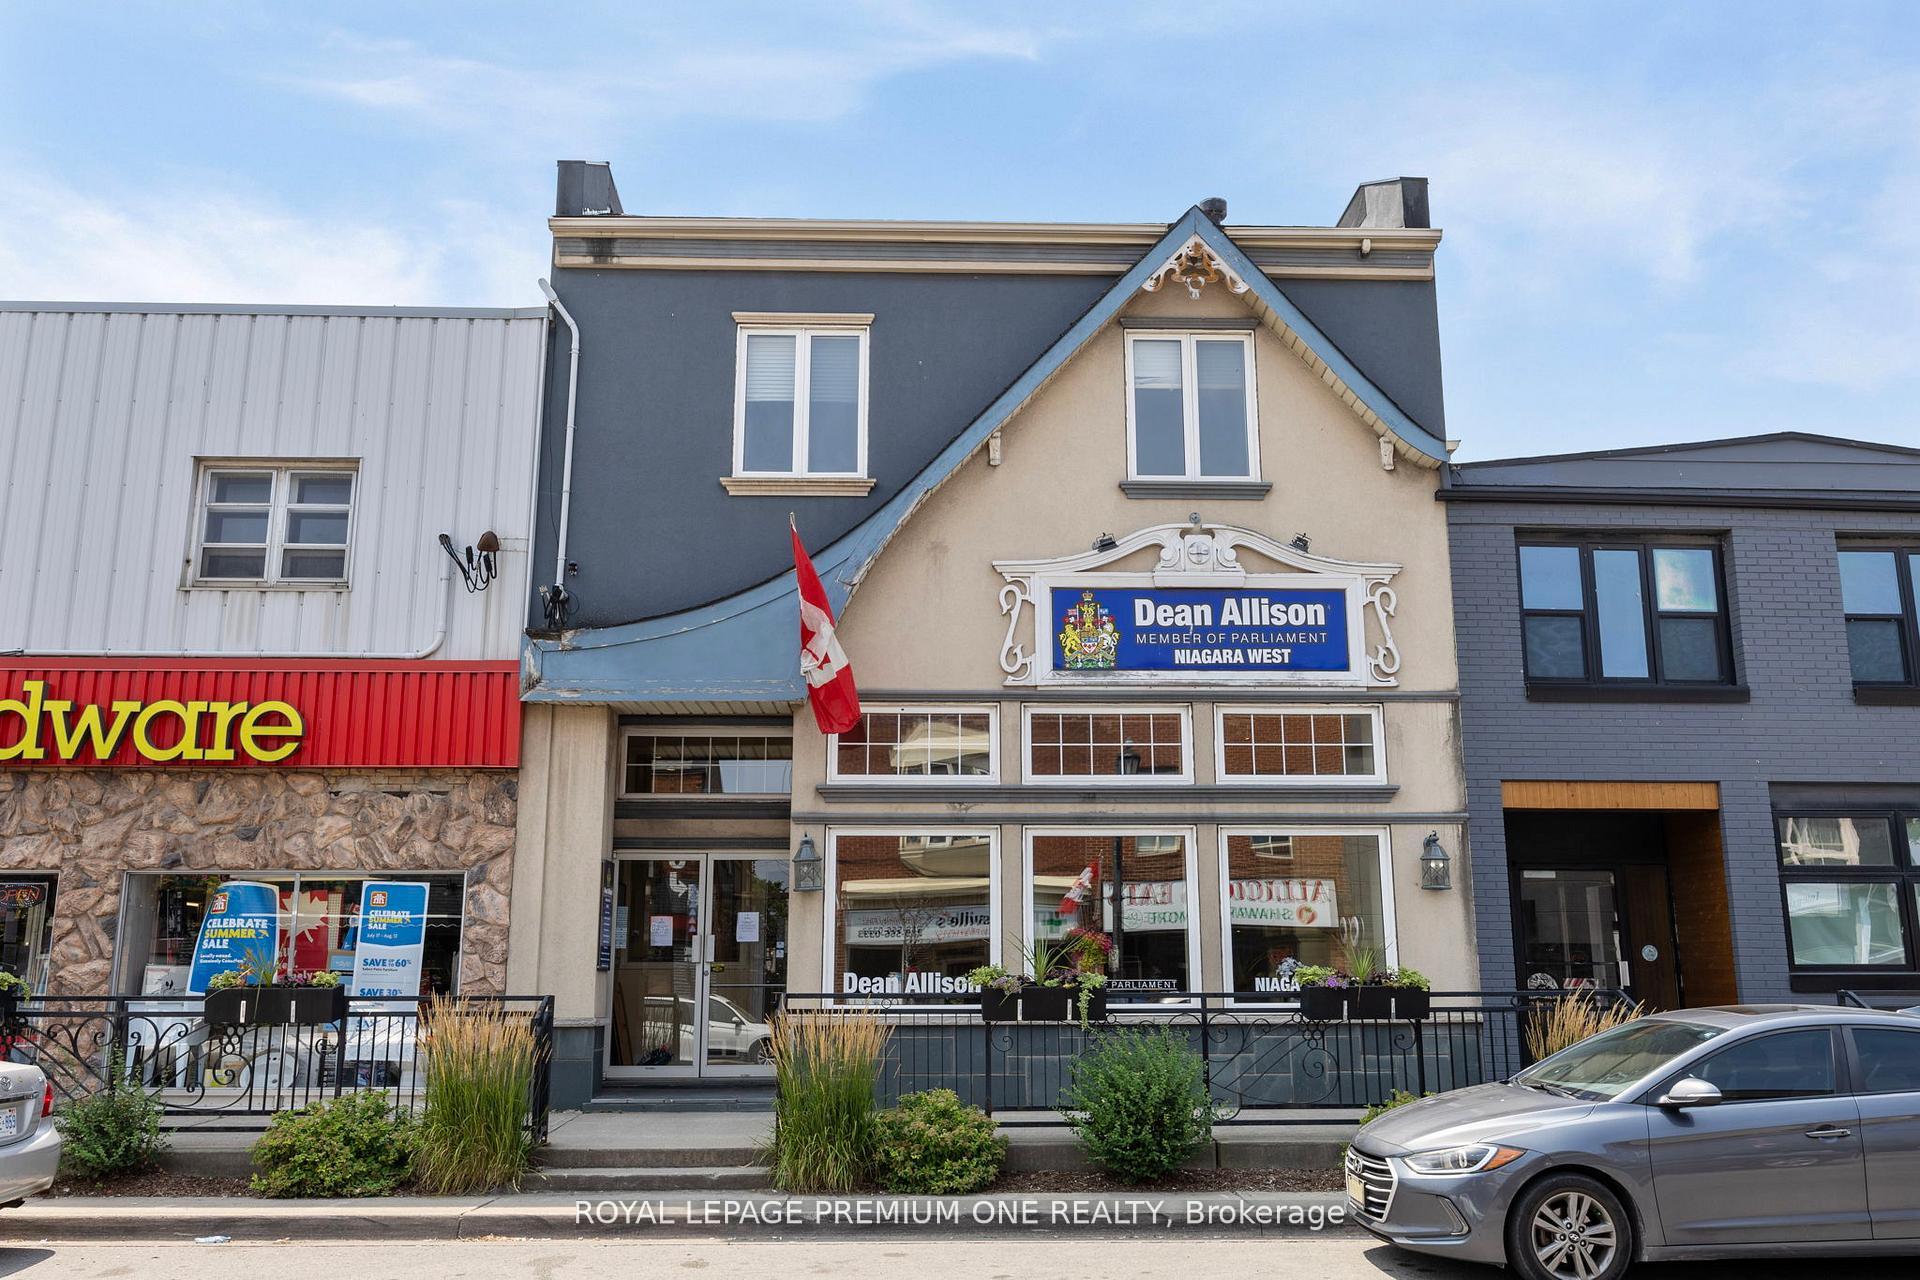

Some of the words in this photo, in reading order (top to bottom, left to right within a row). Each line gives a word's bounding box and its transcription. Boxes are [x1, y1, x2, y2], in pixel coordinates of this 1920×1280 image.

[1134, 598, 1212, 626] Dean
[1220, 598, 1326, 626] Allison
[1136, 633, 1201, 643] MEMBER
[1207, 633, 1226, 643] OF
[1231, 632, 1327, 643] PARLIAMENT
[1174, 649, 1244, 664] NIAGARA
[1248, 649, 1291, 664] WEST
[0, 680, 302, 761] dware
[369, 910, 410, 918] CELEBRATE
[206, 918, 268, 929] CELEBRATE
[204, 929, 256, 939] SUMMER
[202, 939, 229, 949] SALE
[362, 958, 387, 967] SAVE
[843, 972, 899, 994] Dean
[1111, 981, 1177, 989] PARLIAMENT
[360, 988, 384, 997] SAVE
